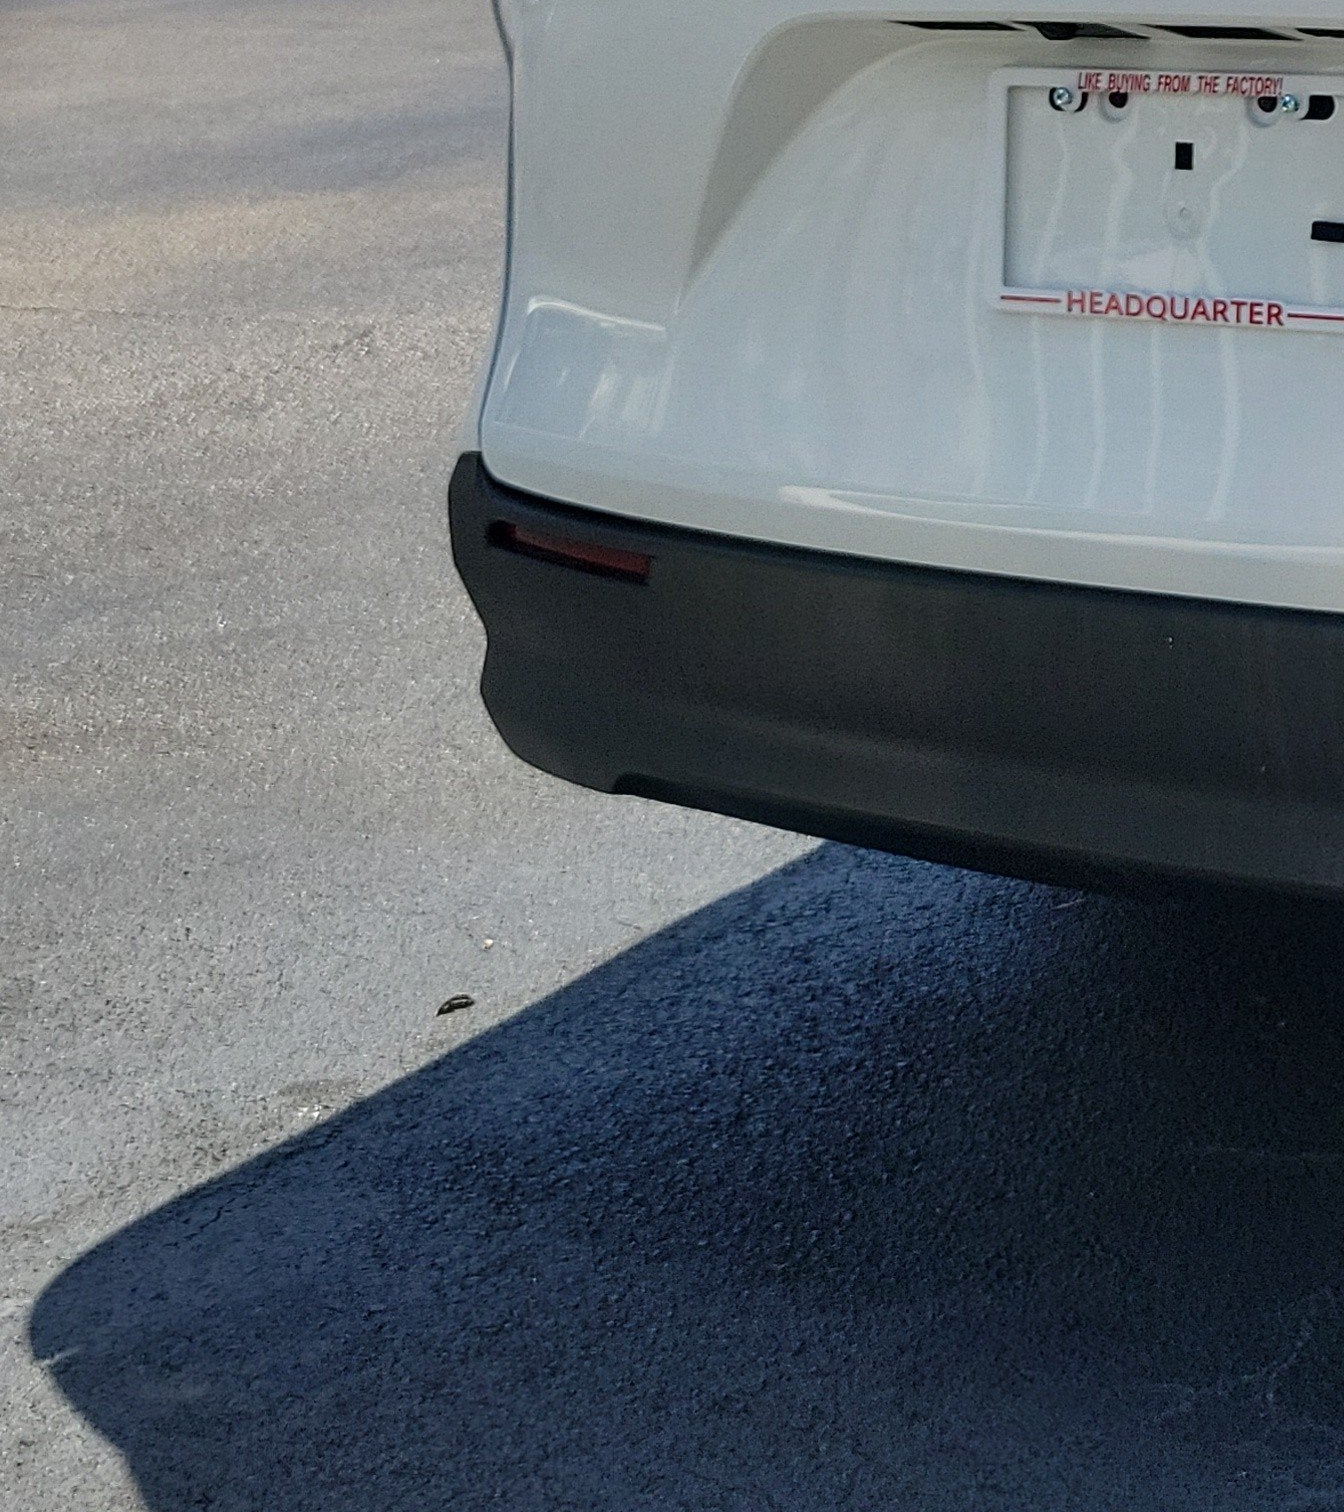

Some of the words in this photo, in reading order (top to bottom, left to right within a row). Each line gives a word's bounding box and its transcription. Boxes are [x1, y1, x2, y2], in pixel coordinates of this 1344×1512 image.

[1078, 72, 1101, 91] LIKE
[1108, 73, 1150, 93] BUYING
[1158, 74, 1190, 93] FROM
[1198, 75, 1220, 94] THE
[1226, 77, 1283, 96] FACTORY!
[1067, 291, 1285, 326] HEADQUARTER
